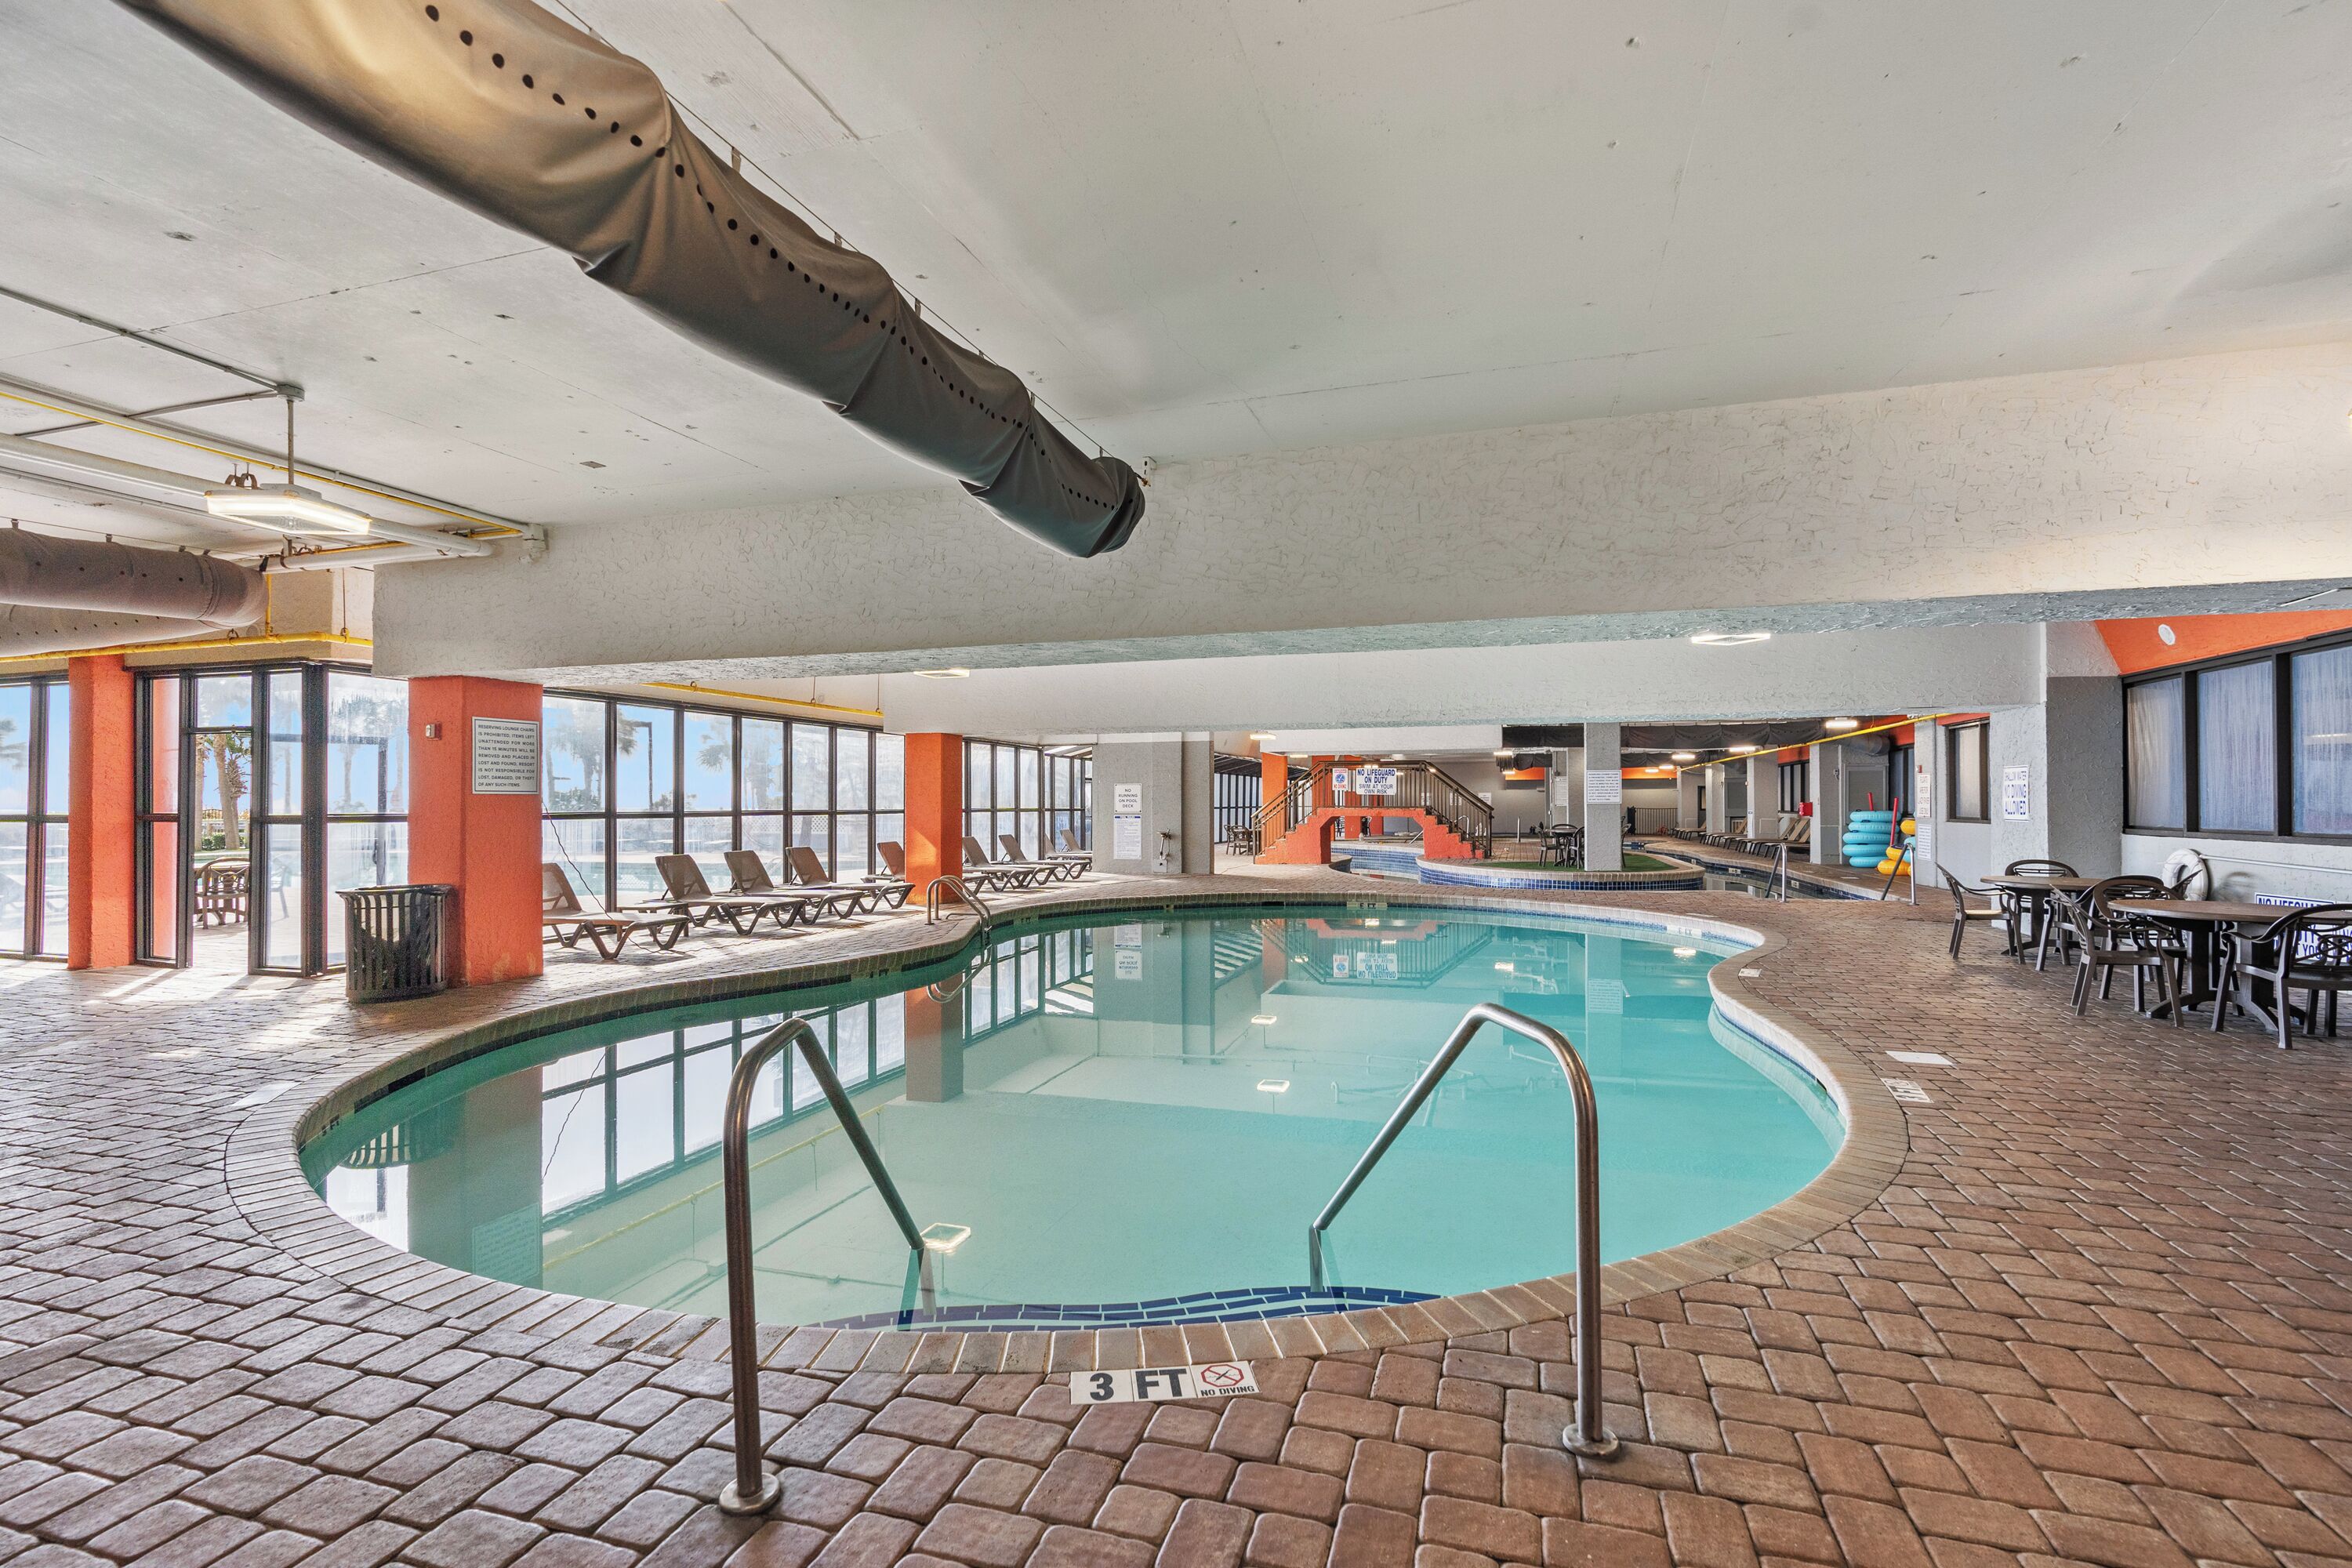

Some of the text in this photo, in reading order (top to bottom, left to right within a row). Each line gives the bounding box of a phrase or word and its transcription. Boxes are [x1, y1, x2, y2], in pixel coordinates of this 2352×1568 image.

[1089, 1368, 1187, 1401] 3 FT
[1201, 1385, 1255, 1397] NO DIVING
